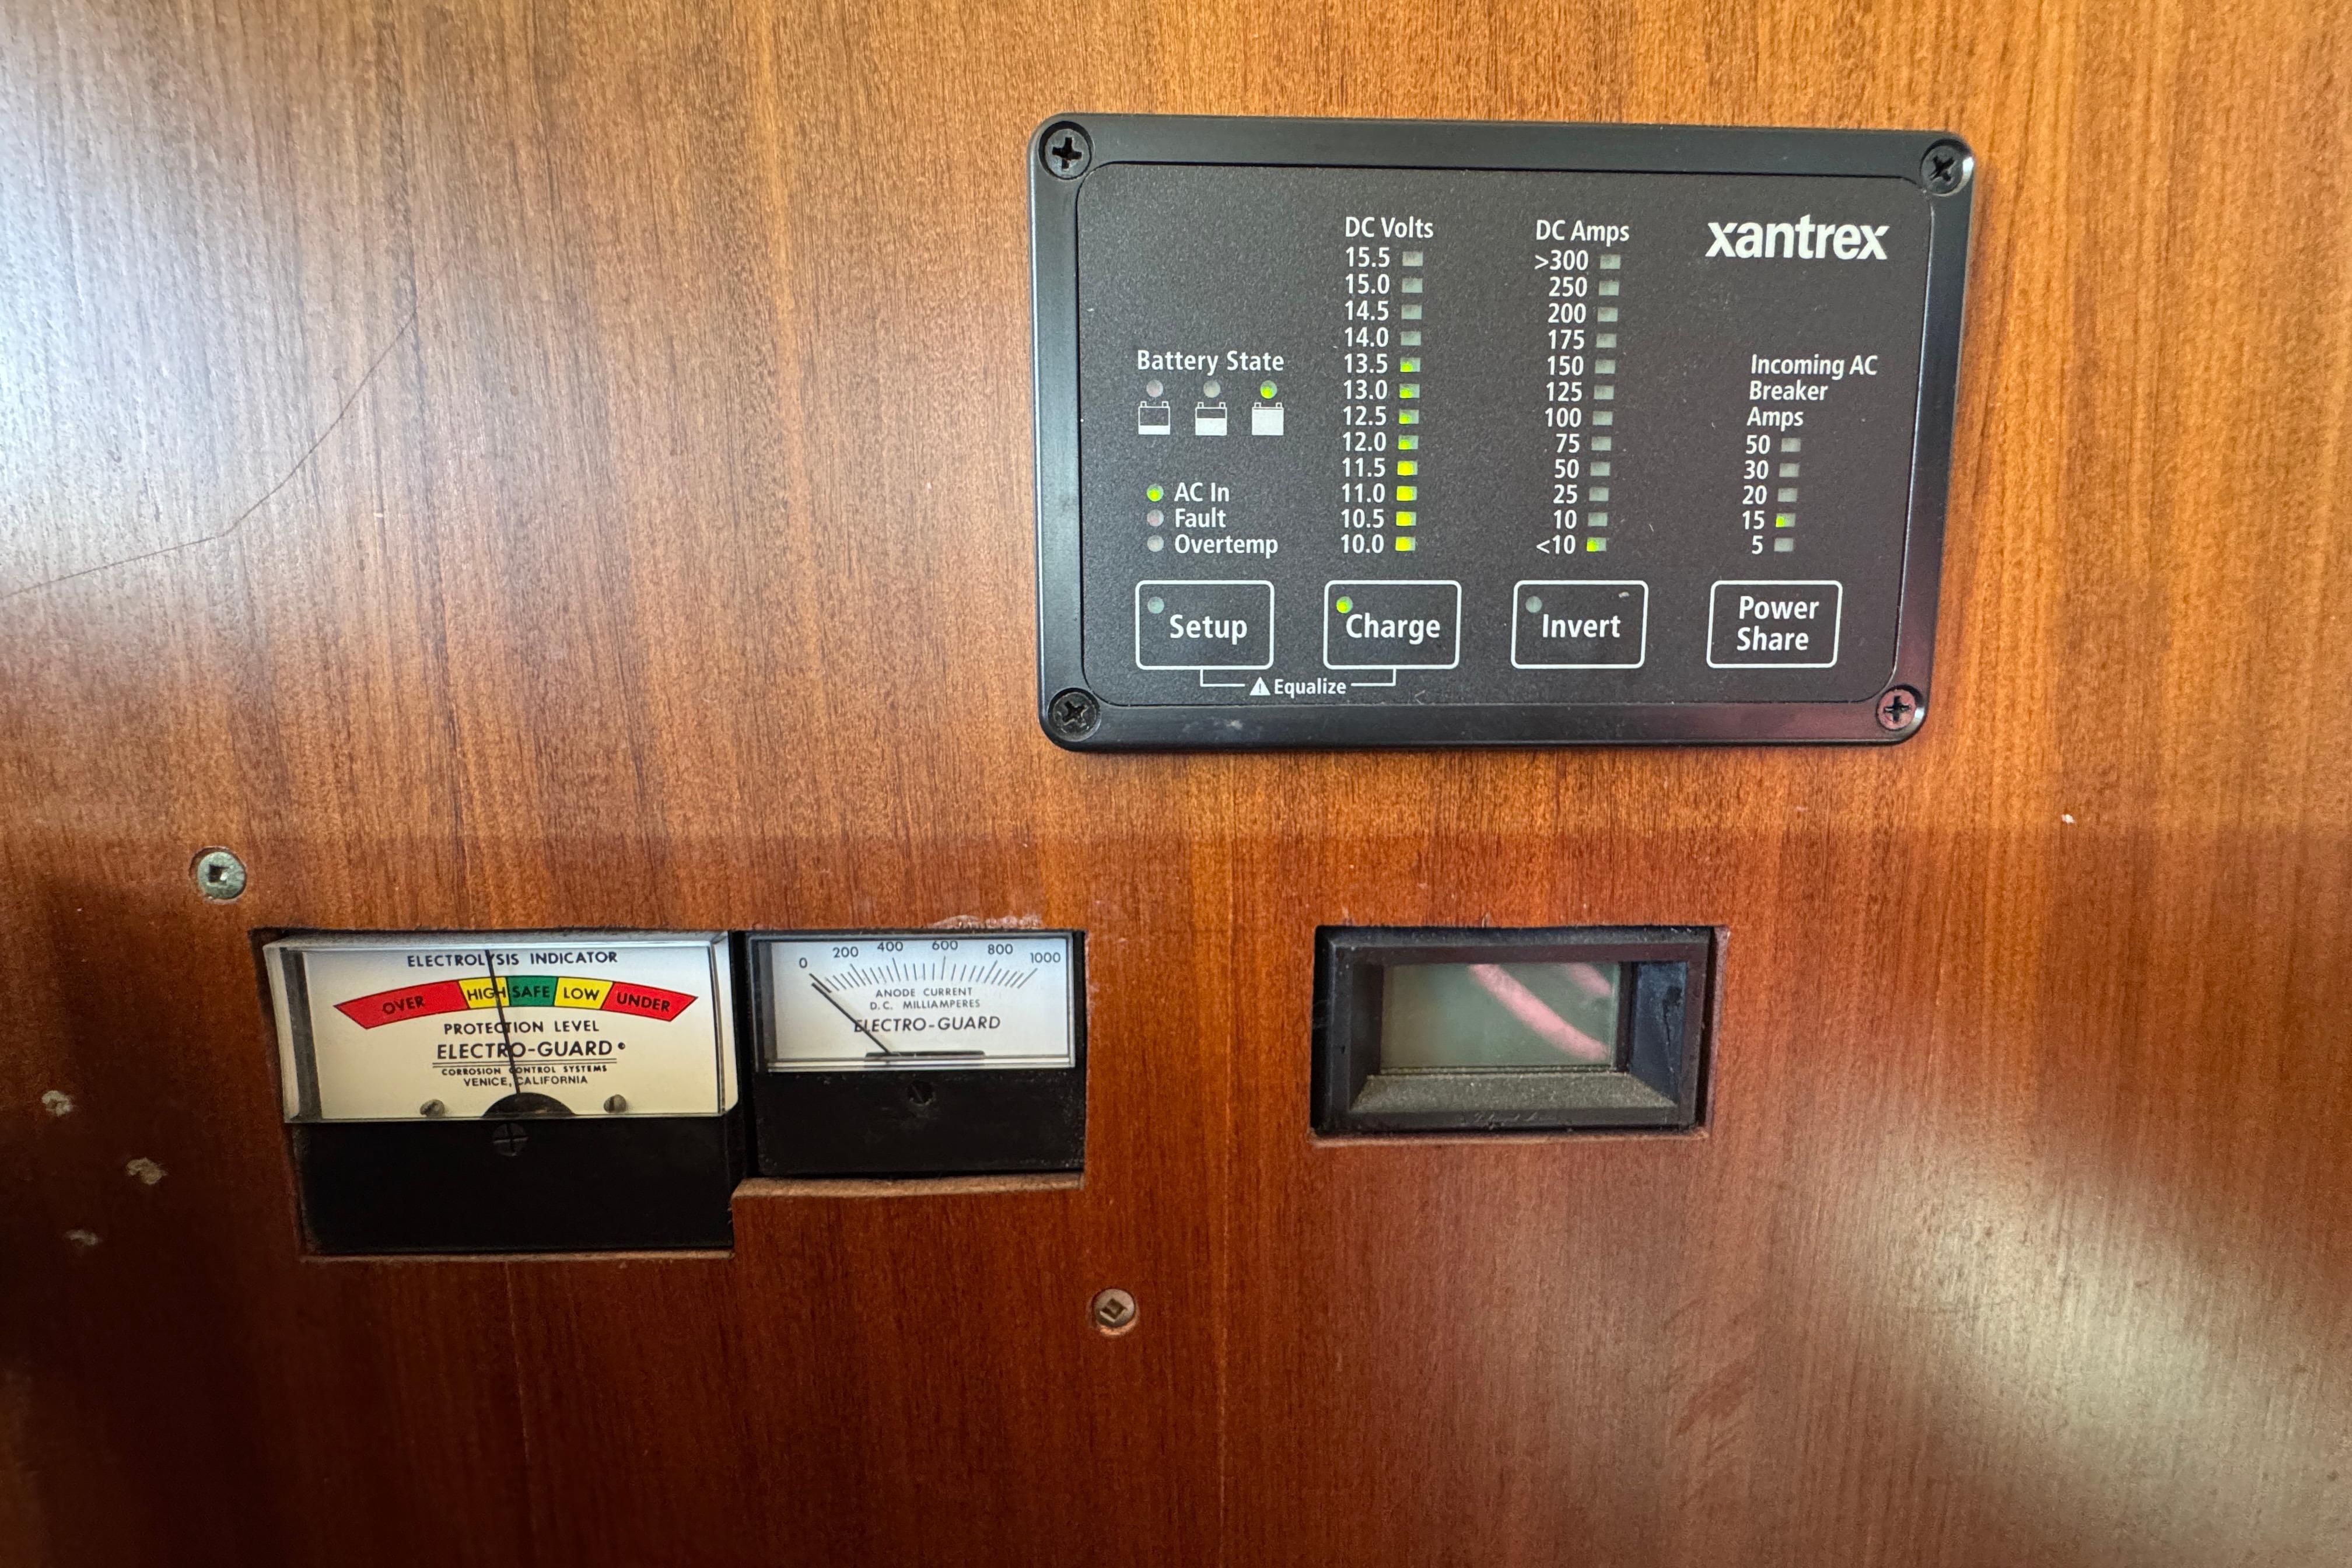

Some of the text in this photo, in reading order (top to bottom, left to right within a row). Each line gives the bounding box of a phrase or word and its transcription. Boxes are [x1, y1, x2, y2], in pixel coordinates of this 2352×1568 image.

[1345, 216, 1434, 239] DC Volts
[1536, 219, 1630, 247] DC Amps
[1705, 214, 1890, 260] xantrex
[1346, 246, 1390, 268] 15.5
[1534, 249, 1588, 271] >300
[1345, 273, 1390, 295] 15.0
[1549, 276, 1588, 298] 250
[1345, 300, 1389, 321] 14.5
[1548, 303, 1586, 324] 200
[1345, 327, 1389, 348] 14.0
[1548, 329, 1585, 350] 175
[1138, 349, 1284, 376] Battery State
[1344, 353, 1388, 374] 13.5
[1547, 355, 1584, 376] 150
[1751, 354, 1878, 380] Incoming AC
[1343, 379, 1388, 400] 13.0
[1546, 382, 1582, 402] 125
[1749, 379, 1829, 401] Breaker
[1343, 405, 1387, 426] 12.5
[1545, 407, 1581, 428] 100
[1746, 406, 1804, 432] Amps
[1342, 431, 1387, 452] 12.0
[1556, 433, 1580, 453] 75
[1745, 435, 1770, 454] 50
[1342, 457, 1385, 478] 11.5
[1555, 459, 1580, 479] 50
[1744, 460, 1769, 480] 30
[1174, 482, 1230, 502] AC In
[1342, 483, 1385, 503] 11.0
[1553, 484, 1578, 504] 25
[1742, 485, 1768, 505] 20
[1175, 507, 1226, 528] Fault
[1341, 508, 1384, 528] 10.5
[1553, 509, 1577, 529] 10
[1742, 510, 1765, 530] 15
[1174, 534, 1278, 559] Overtemp
[1340, 534, 1384, 554] 10.0
[1536, 534, 1576, 554] <10
[1752, 535, 1763, 555] 5
[1739, 596, 1819, 620] Power
[1170, 614, 1248, 645] Setup
[1346, 612, 1440, 645] Charge
[1542, 614, 1621, 638] Invert
[1737, 625, 1809, 651] Share
[1274, 677, 1346, 699] Equalize
[832, 946, 859, 958] 200
[877, 941, 904, 952] 400
[932, 940, 958, 951] 600
[988, 944, 1014, 956] 800
[530, 952, 618, 964] INDICATOR
[799, 957, 807, 969] 0
[1030, 953, 1061, 964] 1000
[467, 986, 506, 1000] HIGH
[513, 986, 550, 998] SAFE
[564, 987, 600, 1000] LOW
[617, 992, 671, 1012] UNDER
[876, 988, 973, 998] ANODE CURRENT
[382, 995, 425, 1014] OVER
[903, 999, 981, 1009] MILLIAMPERES
[444, 1020, 600, 1035] PROTECTION LEVEL
[853, 1016, 1000, 1033] ELECTRO-GUARD
[442, 1067, 501, 1075] CORROSION
[464, 1076, 588, 1087] VENICE, CALIFORNIA
